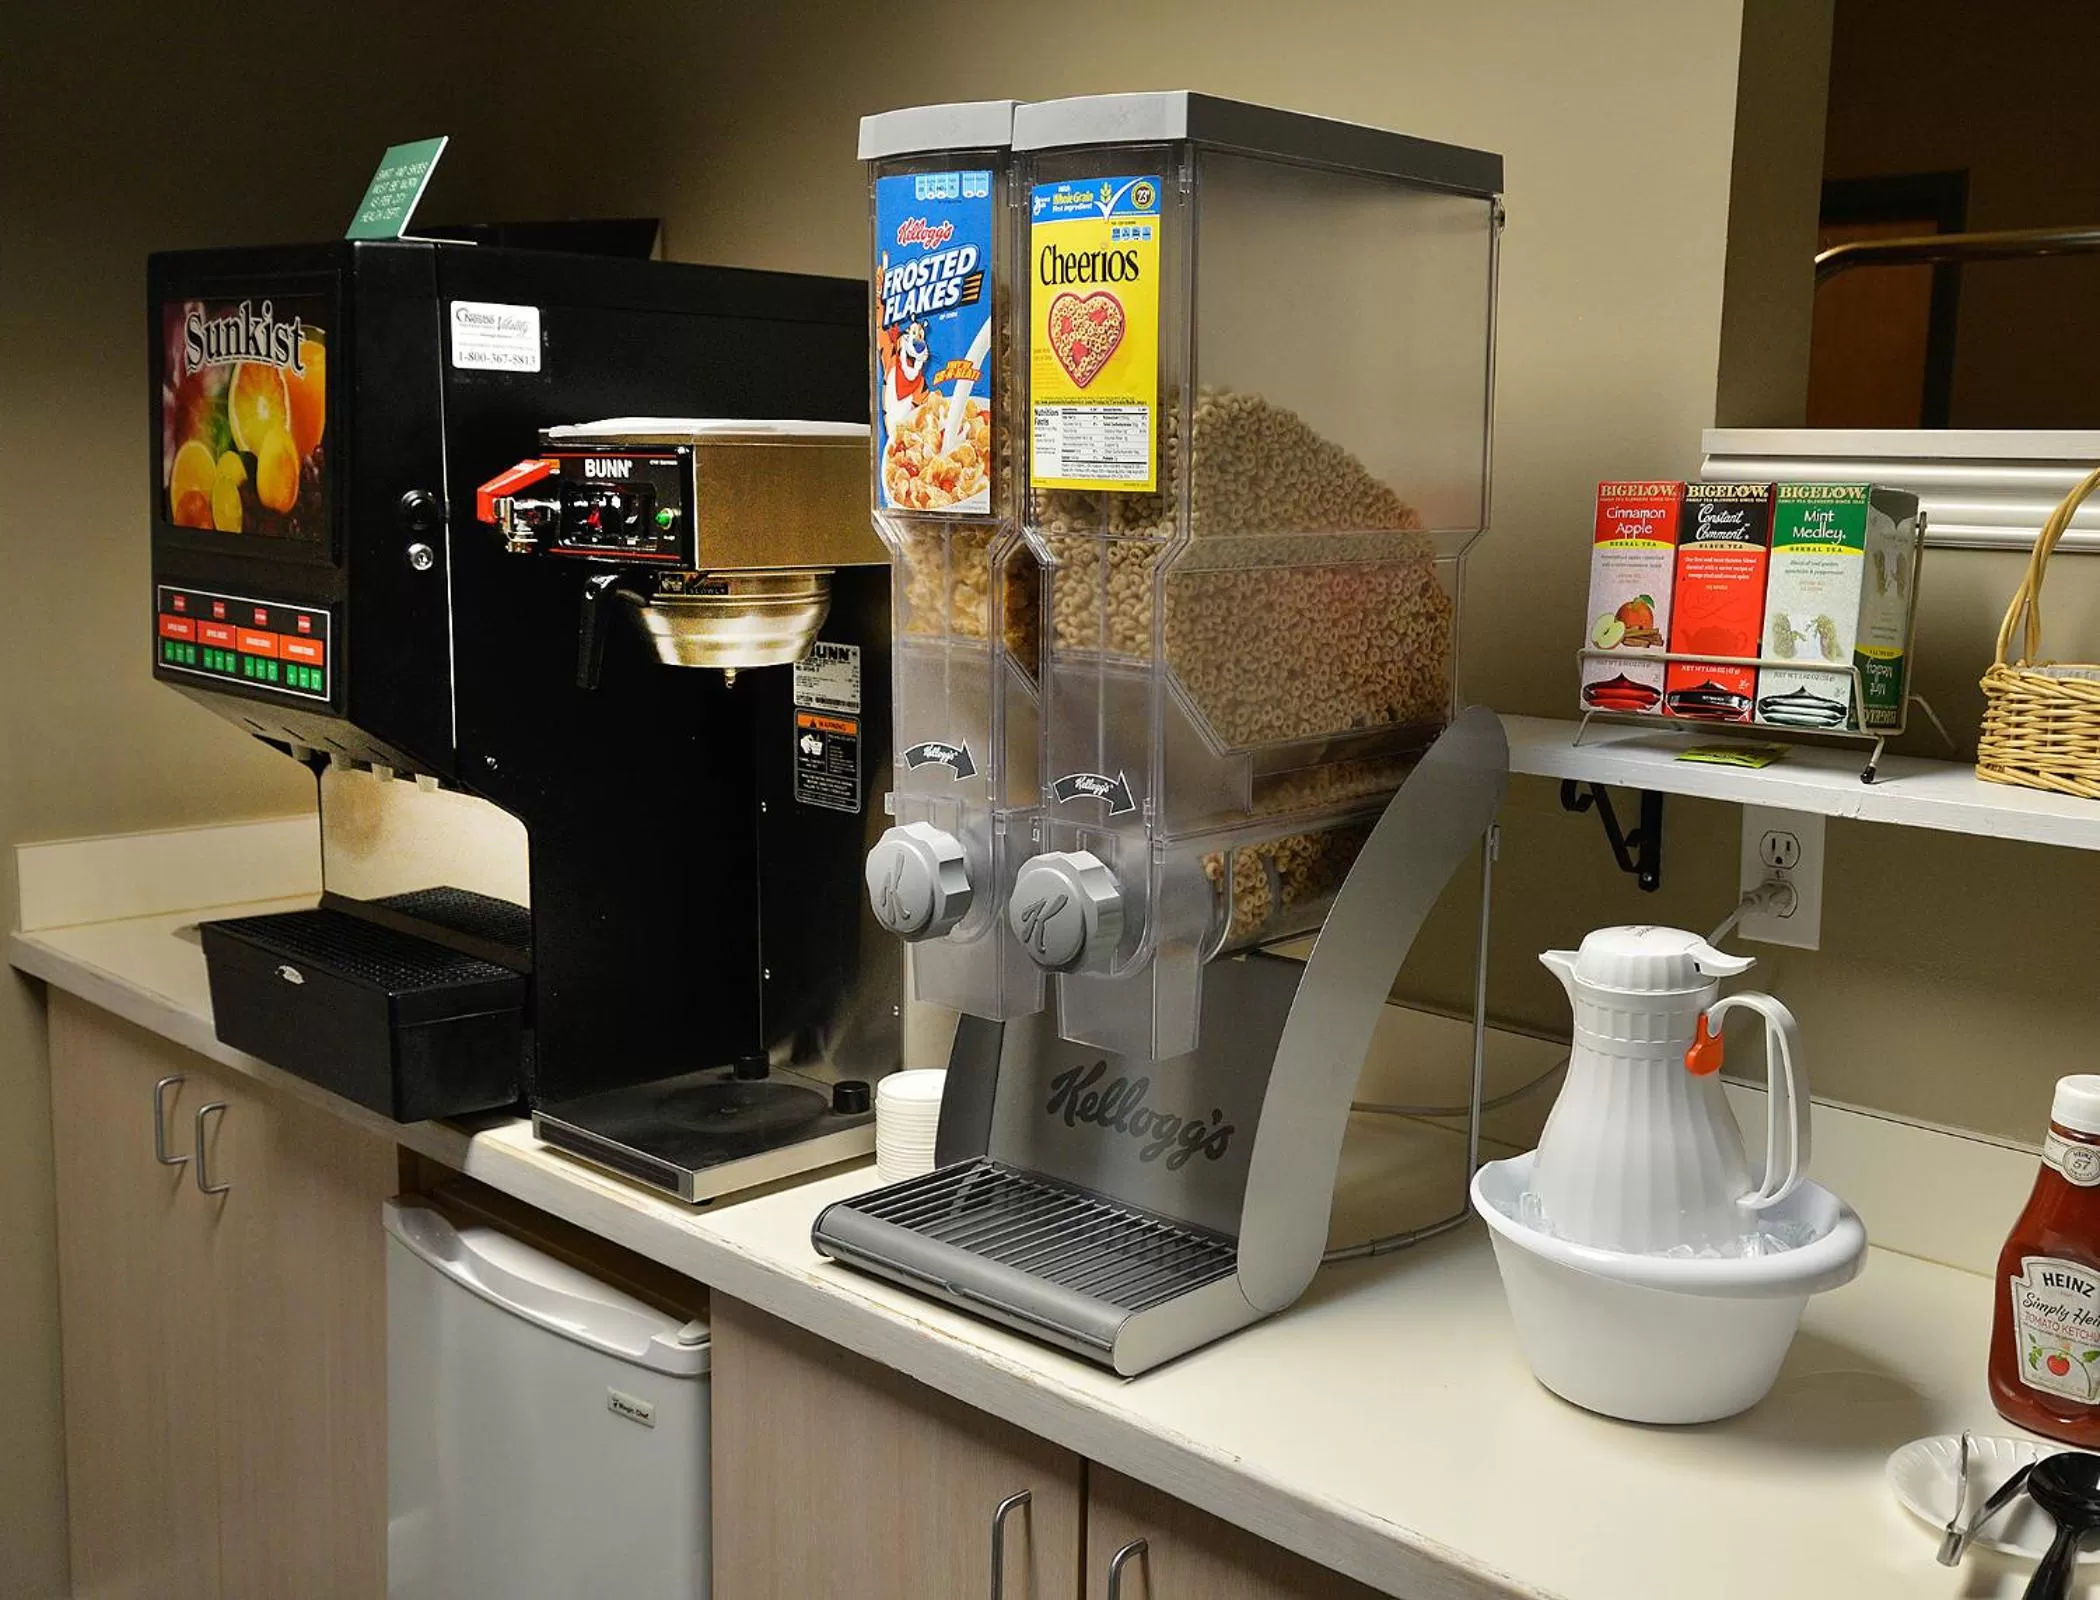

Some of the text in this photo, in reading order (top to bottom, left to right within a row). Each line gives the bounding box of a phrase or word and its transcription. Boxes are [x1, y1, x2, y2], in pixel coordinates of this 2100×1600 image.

[1052, 190, 1094, 204] Whole Grain
[898, 217, 954, 249] Kellogg's
[882, 248, 978, 299] FROSTED
[1040, 243, 1140, 285] Cheerios
[884, 278, 963, 326] FLAKES
[184, 299, 306, 379] Sunkist
[585, 458, 630, 478] BUNN
[1601, 483, 1677, 497] BIGELOW
[1686, 484, 1769, 498] BIGELOW
[1780, 486, 1864, 499] BIGELOW
[1606, 507, 1666, 519] Cinnamon
[1803, 508, 1835, 522] Mint
[1615, 520, 1653, 539] Apple
[1792, 523, 1843, 545] Medley
[923, 744, 958, 764] Kellogg's
[1075, 776, 1114, 796] Kellogg's
[1046, 1059, 1236, 1172] Kellogg's
[2072, 1159, 2091, 1171] 57
[2042, 1272, 2096, 1298] HEINZ
[2022, 1291, 2070, 1322] Simply
[2024, 1311, 2061, 1332] TOMATO
